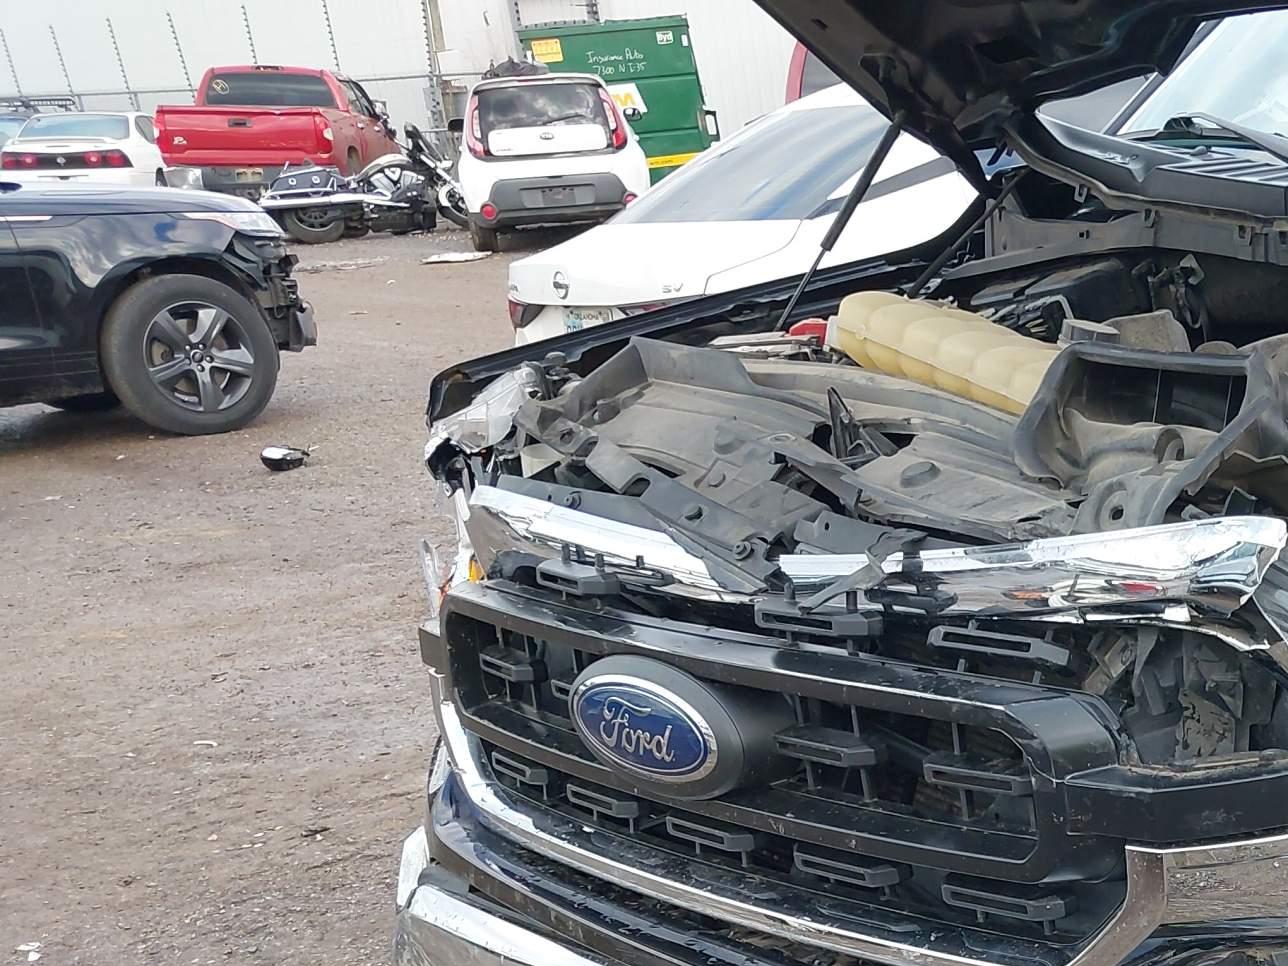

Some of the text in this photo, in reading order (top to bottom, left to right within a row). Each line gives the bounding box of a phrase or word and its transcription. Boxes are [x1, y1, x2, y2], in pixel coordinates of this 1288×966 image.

[585, 47, 644, 64] Insurance Auto
[592, 61, 648, 76] 7300 N I-35
[599, 696, 675, 763] Ford
